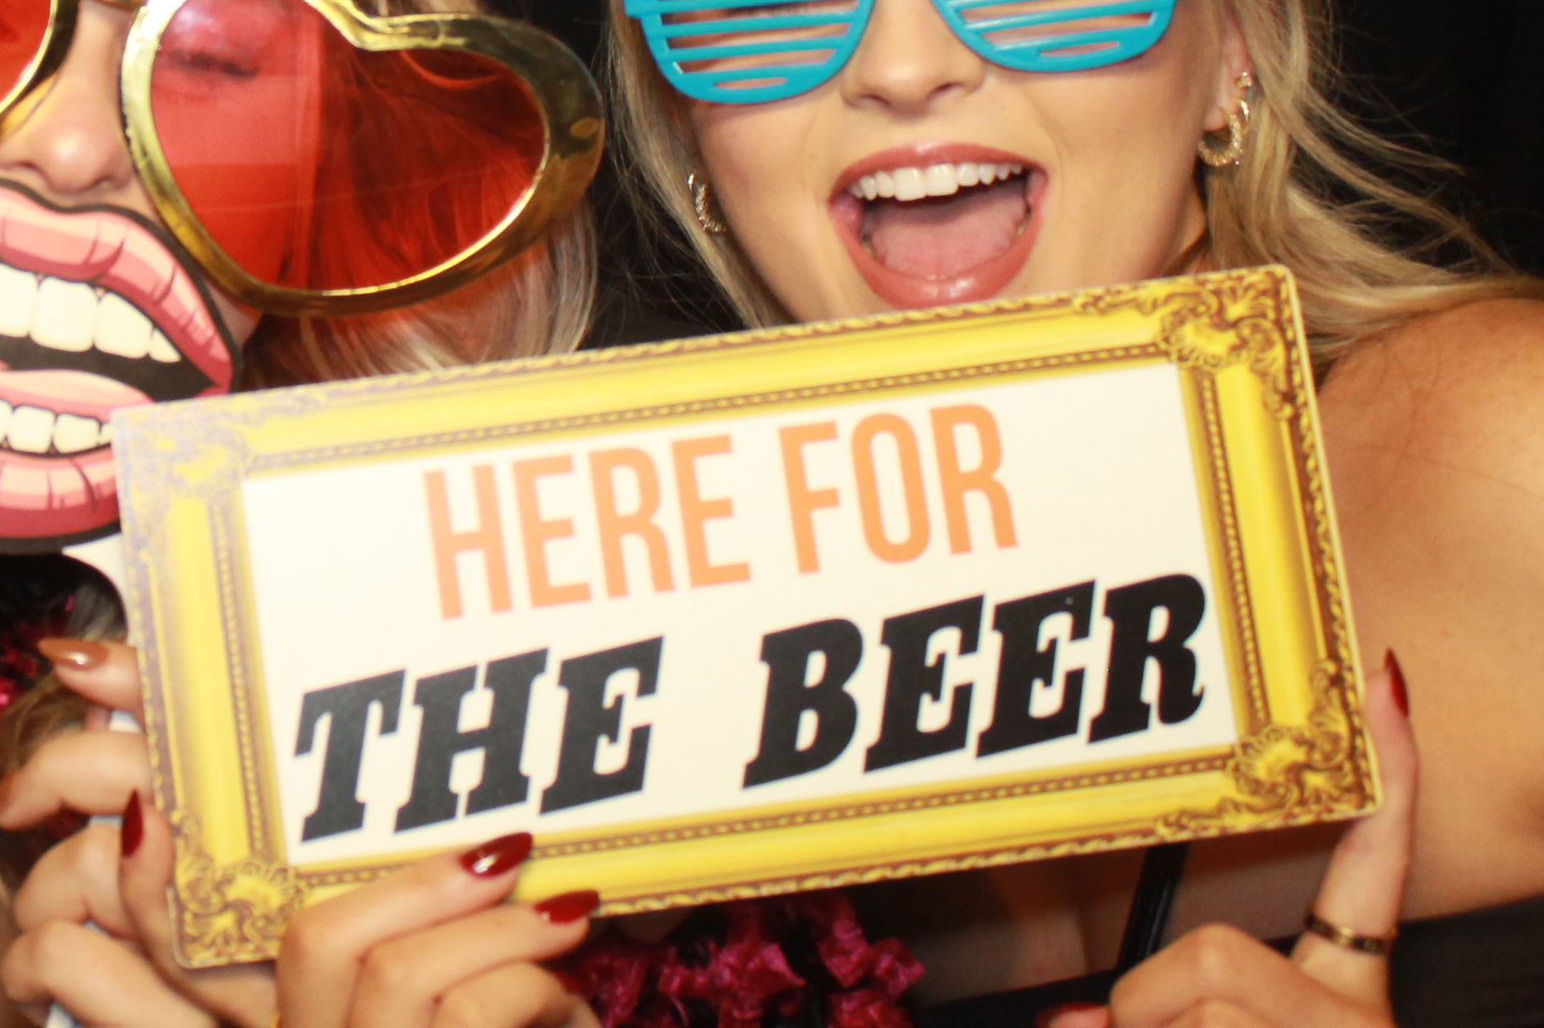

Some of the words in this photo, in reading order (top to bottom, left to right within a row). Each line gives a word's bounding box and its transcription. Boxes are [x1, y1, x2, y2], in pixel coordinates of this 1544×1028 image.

[425, 435, 750, 618] HERE
[779, 404, 1018, 573] FOR
[294, 637, 664, 842] THE
[743, 574, 1206, 789] BEER
